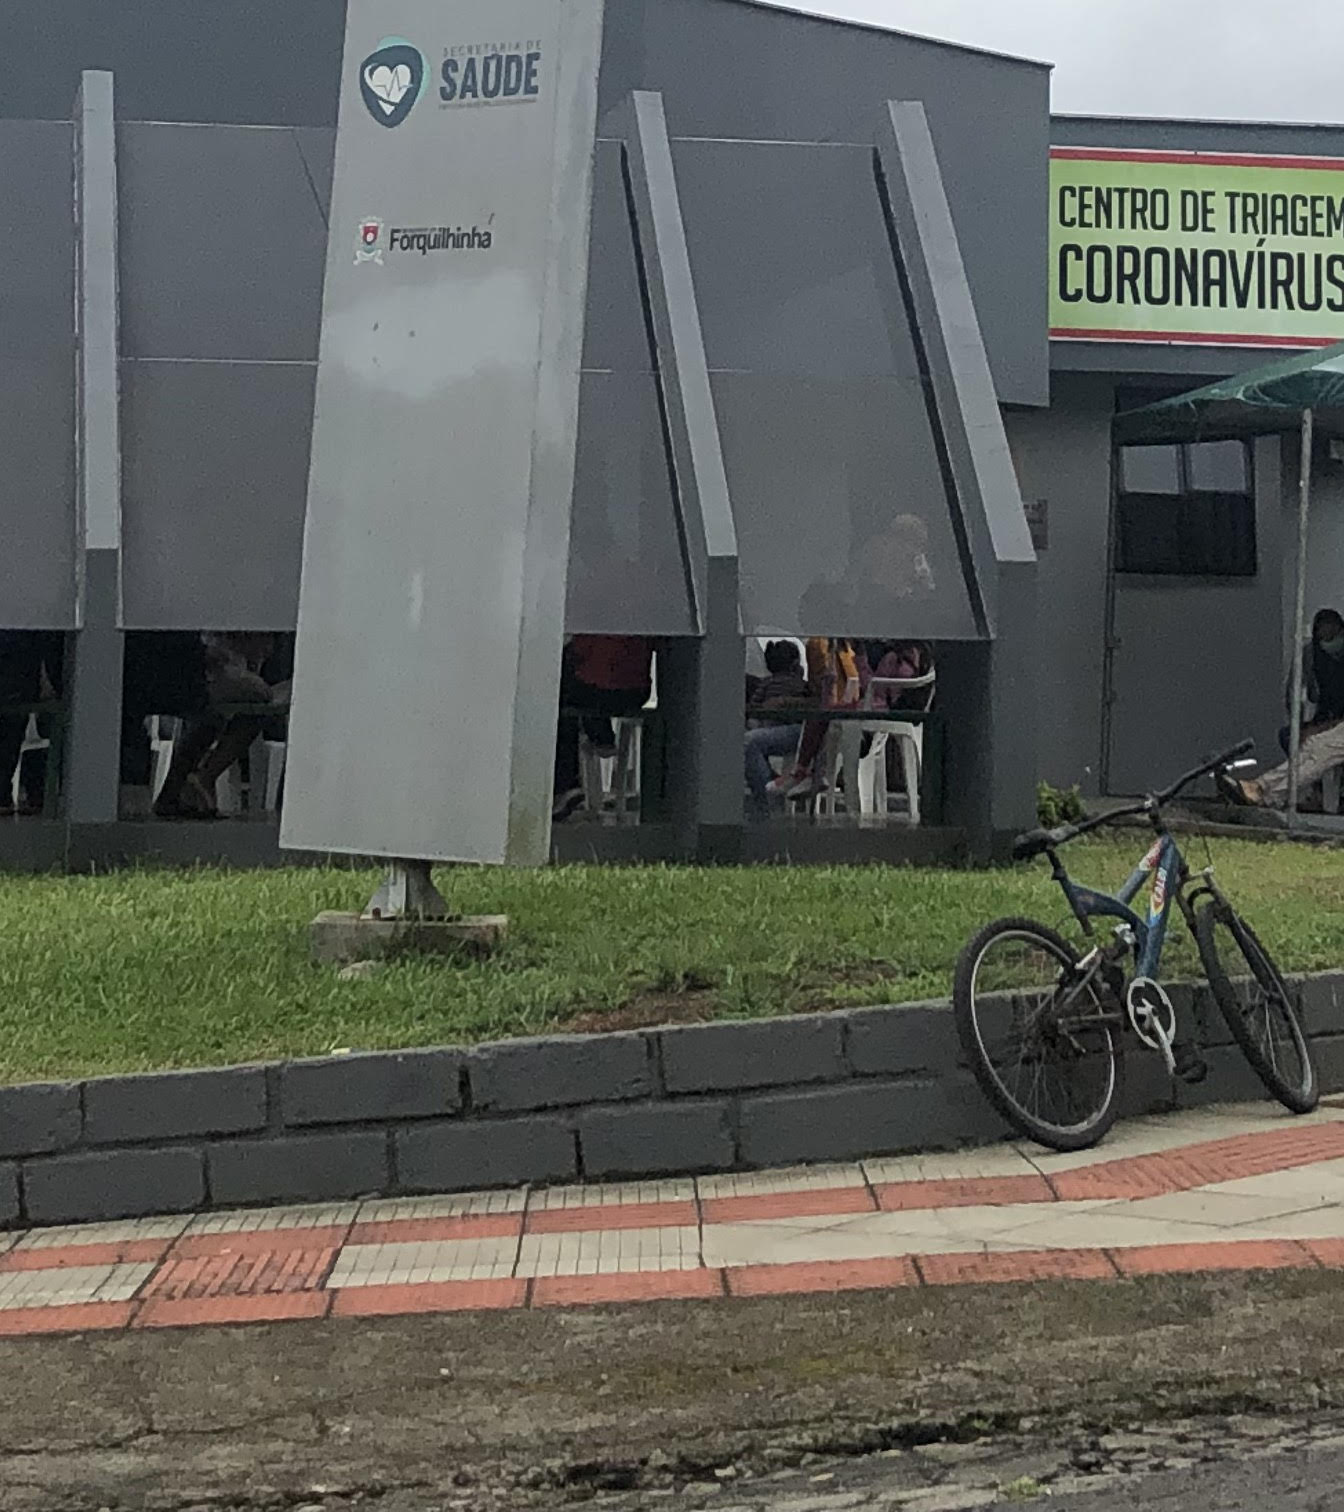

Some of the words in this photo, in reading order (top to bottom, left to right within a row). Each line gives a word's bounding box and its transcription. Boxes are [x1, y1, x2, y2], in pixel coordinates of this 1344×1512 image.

[526, 39, 542, 51] DE
[439, 52, 542, 102] SAÚDE
[1058, 184, 1170, 232] CENTRO
[1180, 189, 1217, 233] DE
